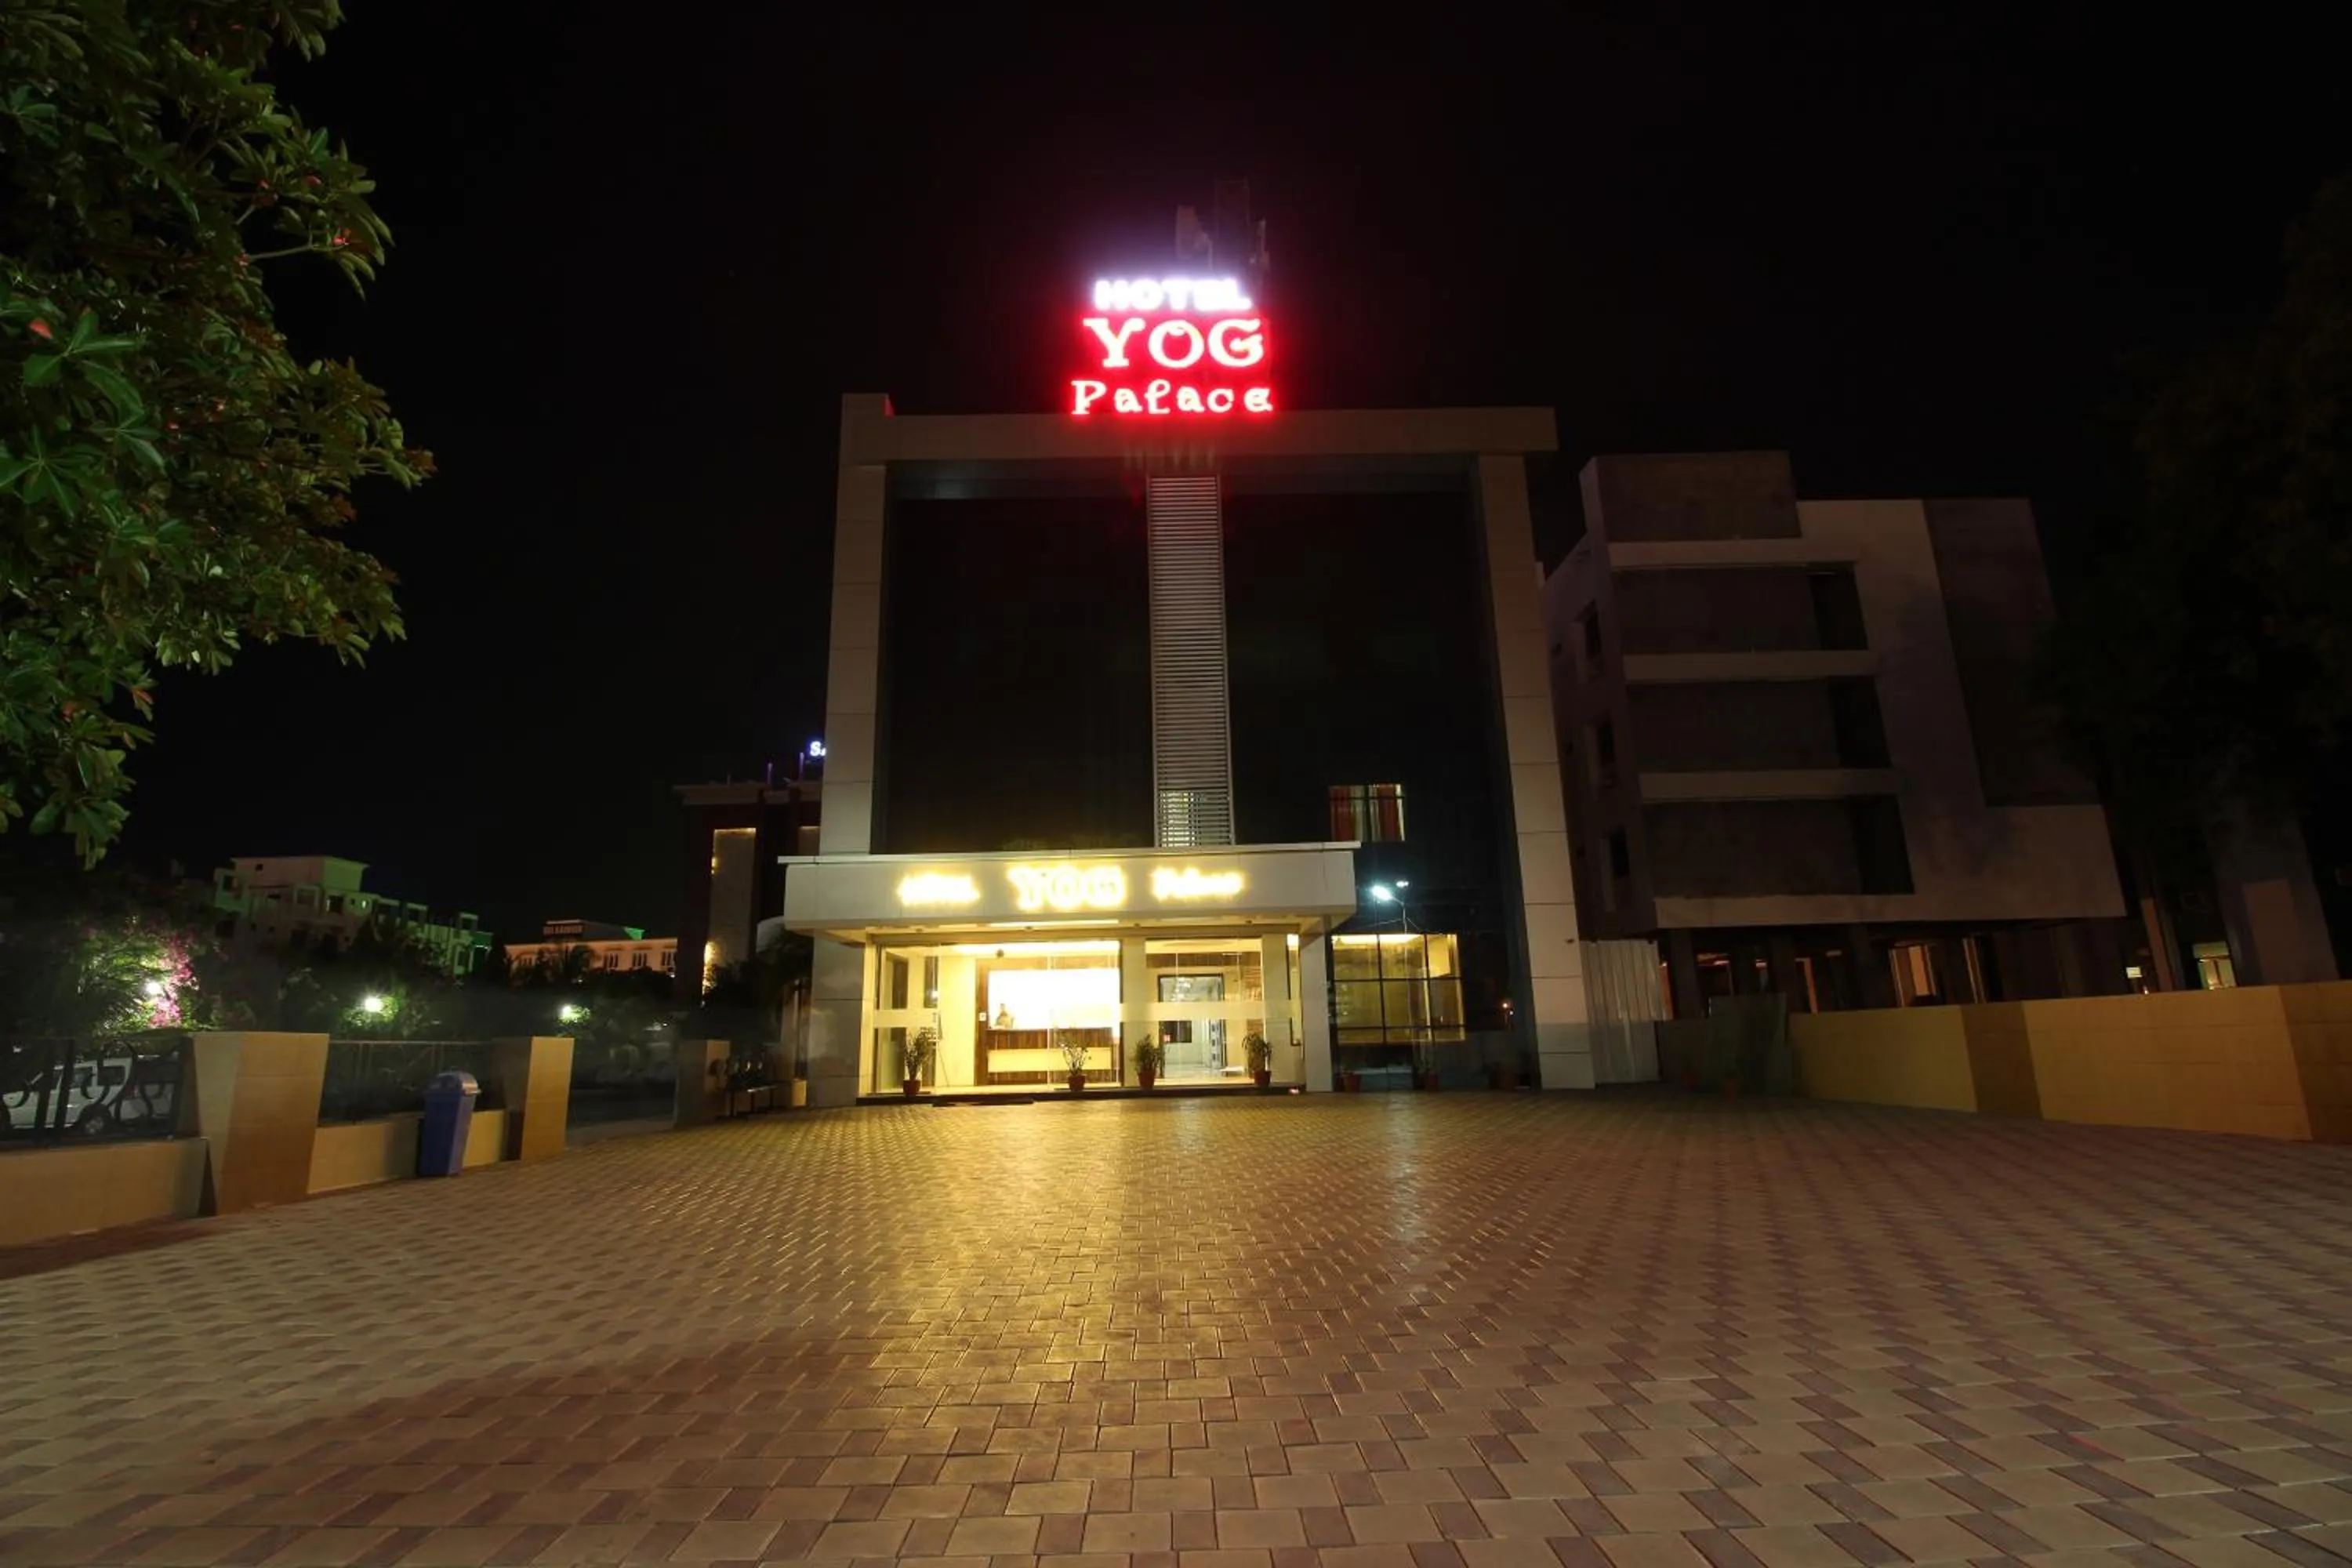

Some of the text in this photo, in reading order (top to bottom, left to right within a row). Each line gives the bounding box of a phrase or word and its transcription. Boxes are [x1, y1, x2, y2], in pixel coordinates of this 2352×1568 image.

[1094, 278, 1252, 310] HOTEL
[1083, 317, 1265, 368] YOG
[1071, 379, 1273, 414] Palace
